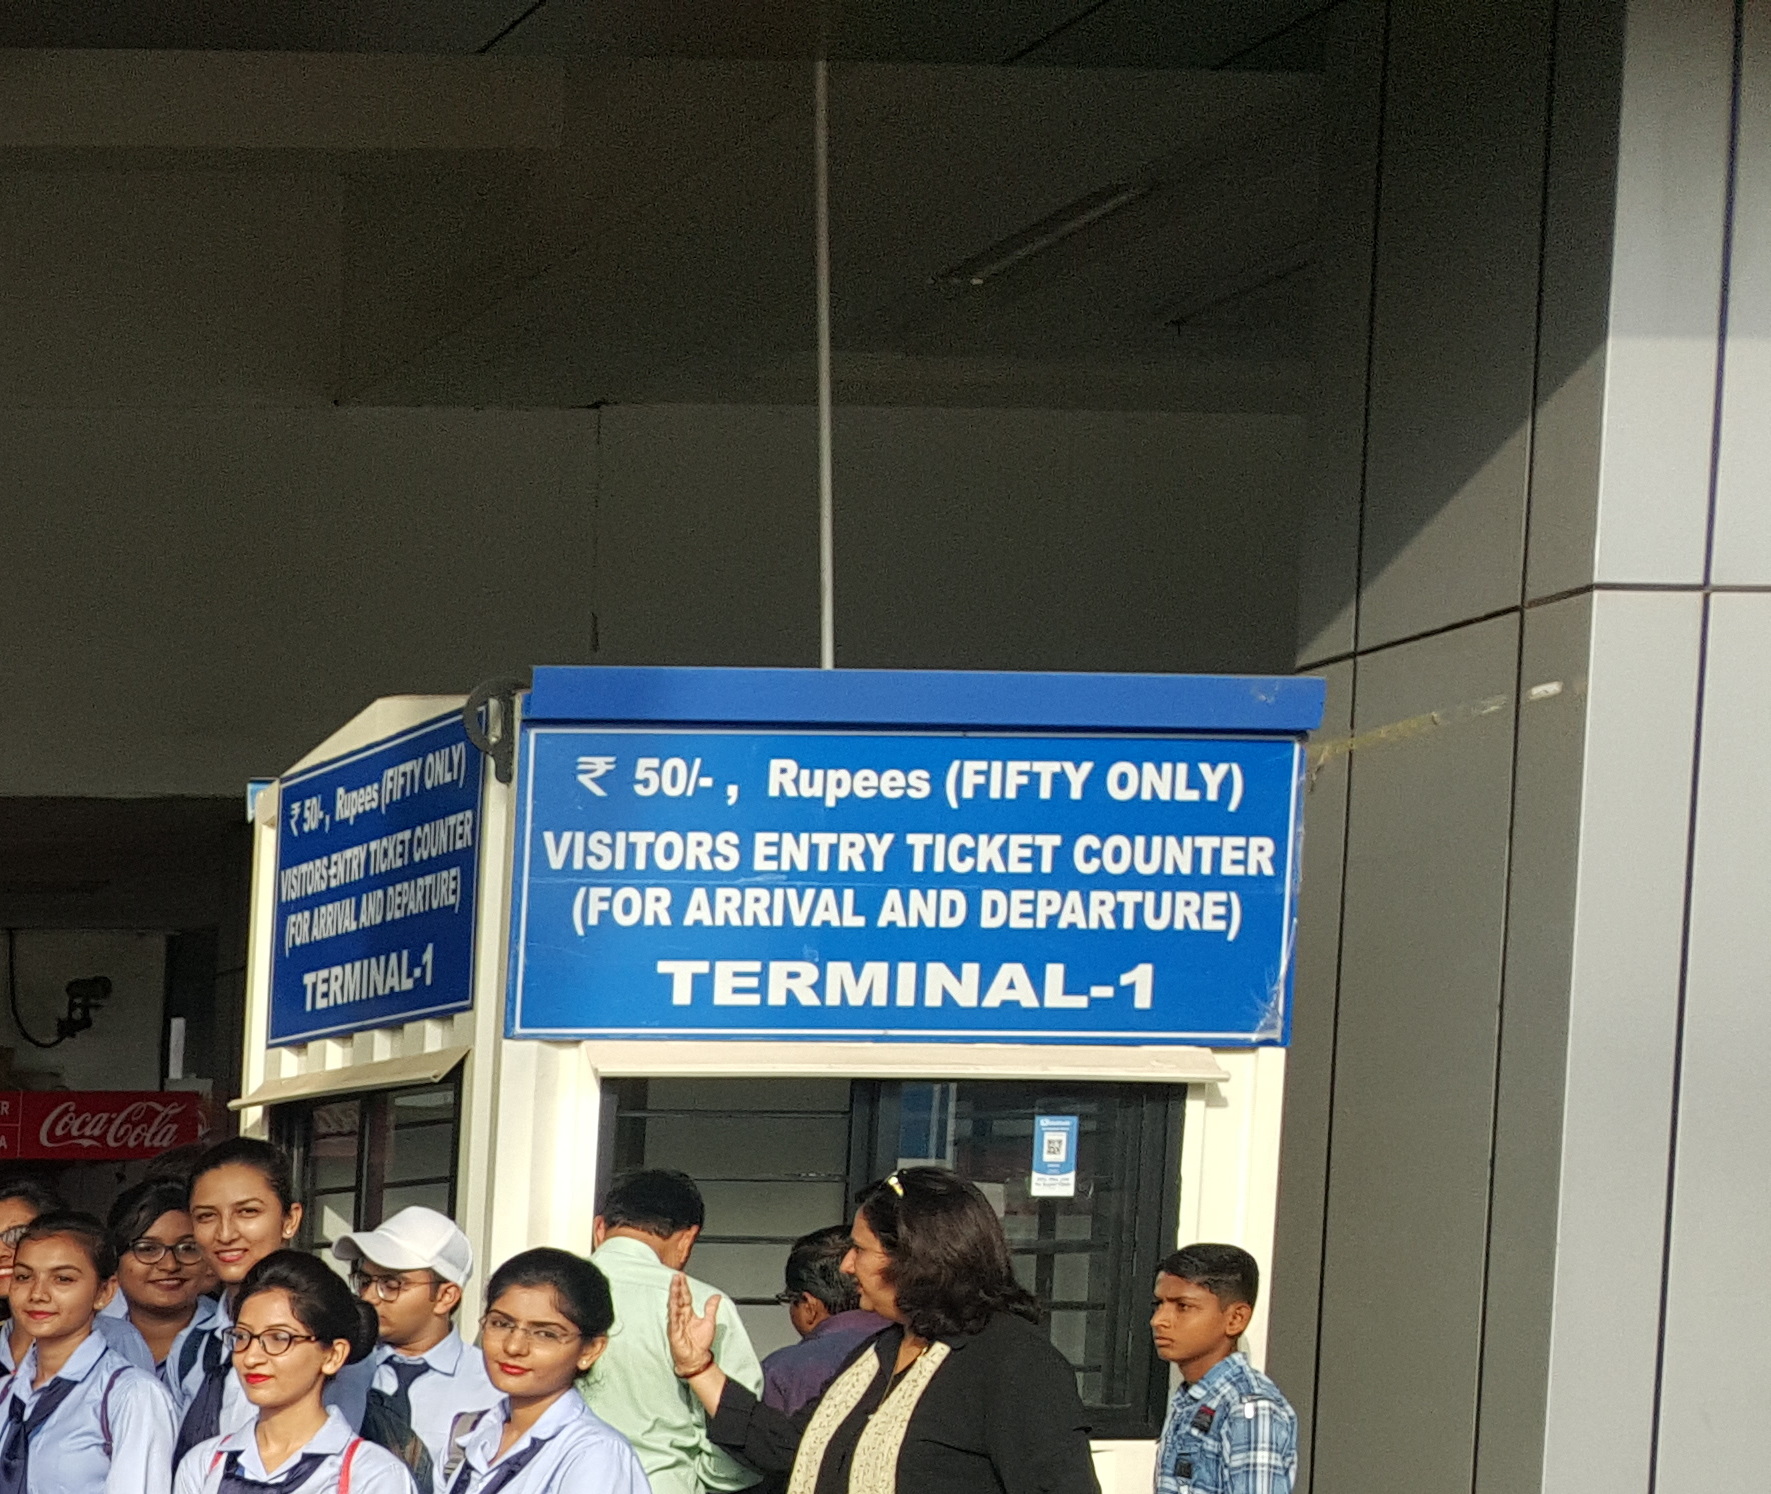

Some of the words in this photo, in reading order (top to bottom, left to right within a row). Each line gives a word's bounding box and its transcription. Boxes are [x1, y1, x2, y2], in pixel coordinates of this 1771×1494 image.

[335, 782, 379, 825] Rupees
[381, 757, 422, 814] (FIFTY
[425, 741, 466, 788] ONLY)
[576, 756, 617, 797] ₹
[768, 758, 931, 808] Rupees
[946, 760, 1094, 809] (FIFTY
[1107, 762, 1244, 812] ONLY)
[281, 856, 328, 903] VISITORS
[329, 843, 367, 888] ENTRY
[369, 829, 412, 876] TICKET
[413, 809, 472, 862] COUNTER
[542, 831, 740, 871] VISITORS
[754, 832, 894, 872] ENTRY
[906, 833, 1062, 874] TICKET
[1073, 835, 1275, 876] COUNTER
[285, 910, 310, 958] (FOR
[311, 897, 357, 942] ARRIVAL
[358, 889, 384, 929] AND
[385, 866, 461, 921] DEPARTURE)
[573, 887, 672, 936] (FOR
[683, 888, 866, 928] ARRIVAL
[876, 888, 966, 928] AND
[980, 889, 1242, 941] DEPARTURE)
[303, 943, 434, 1012] TERMINAL-1
[657, 960, 1154, 1009] TERMINAL-1
[39, 1101, 186, 1148] Coca-Cola
